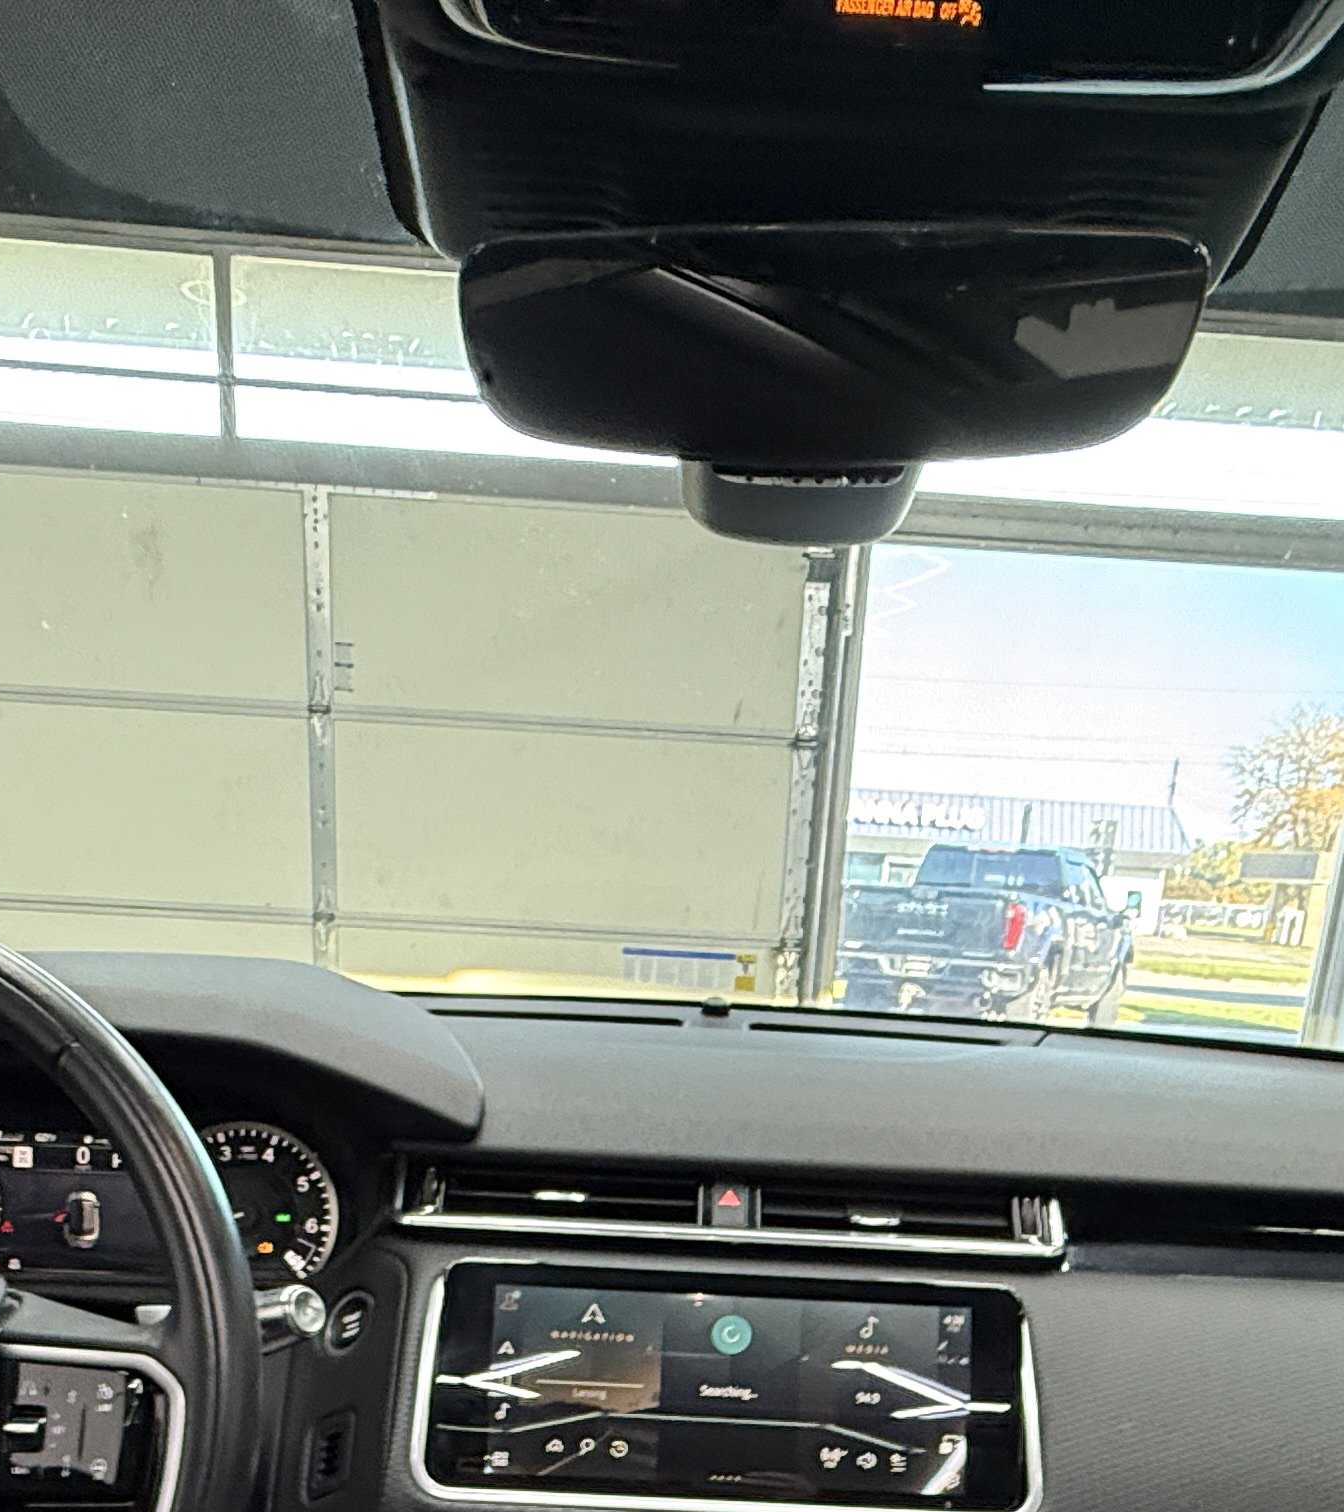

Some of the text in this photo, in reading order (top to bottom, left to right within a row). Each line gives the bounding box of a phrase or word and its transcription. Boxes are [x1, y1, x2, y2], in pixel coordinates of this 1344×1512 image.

[940, 1, 957, 20] OFF
[219, 1145, 232, 1162] 3
[262, 1147, 275, 1163] 4
[296, 1175, 310, 1193] 5
[305, 1217, 319, 1234] 6
